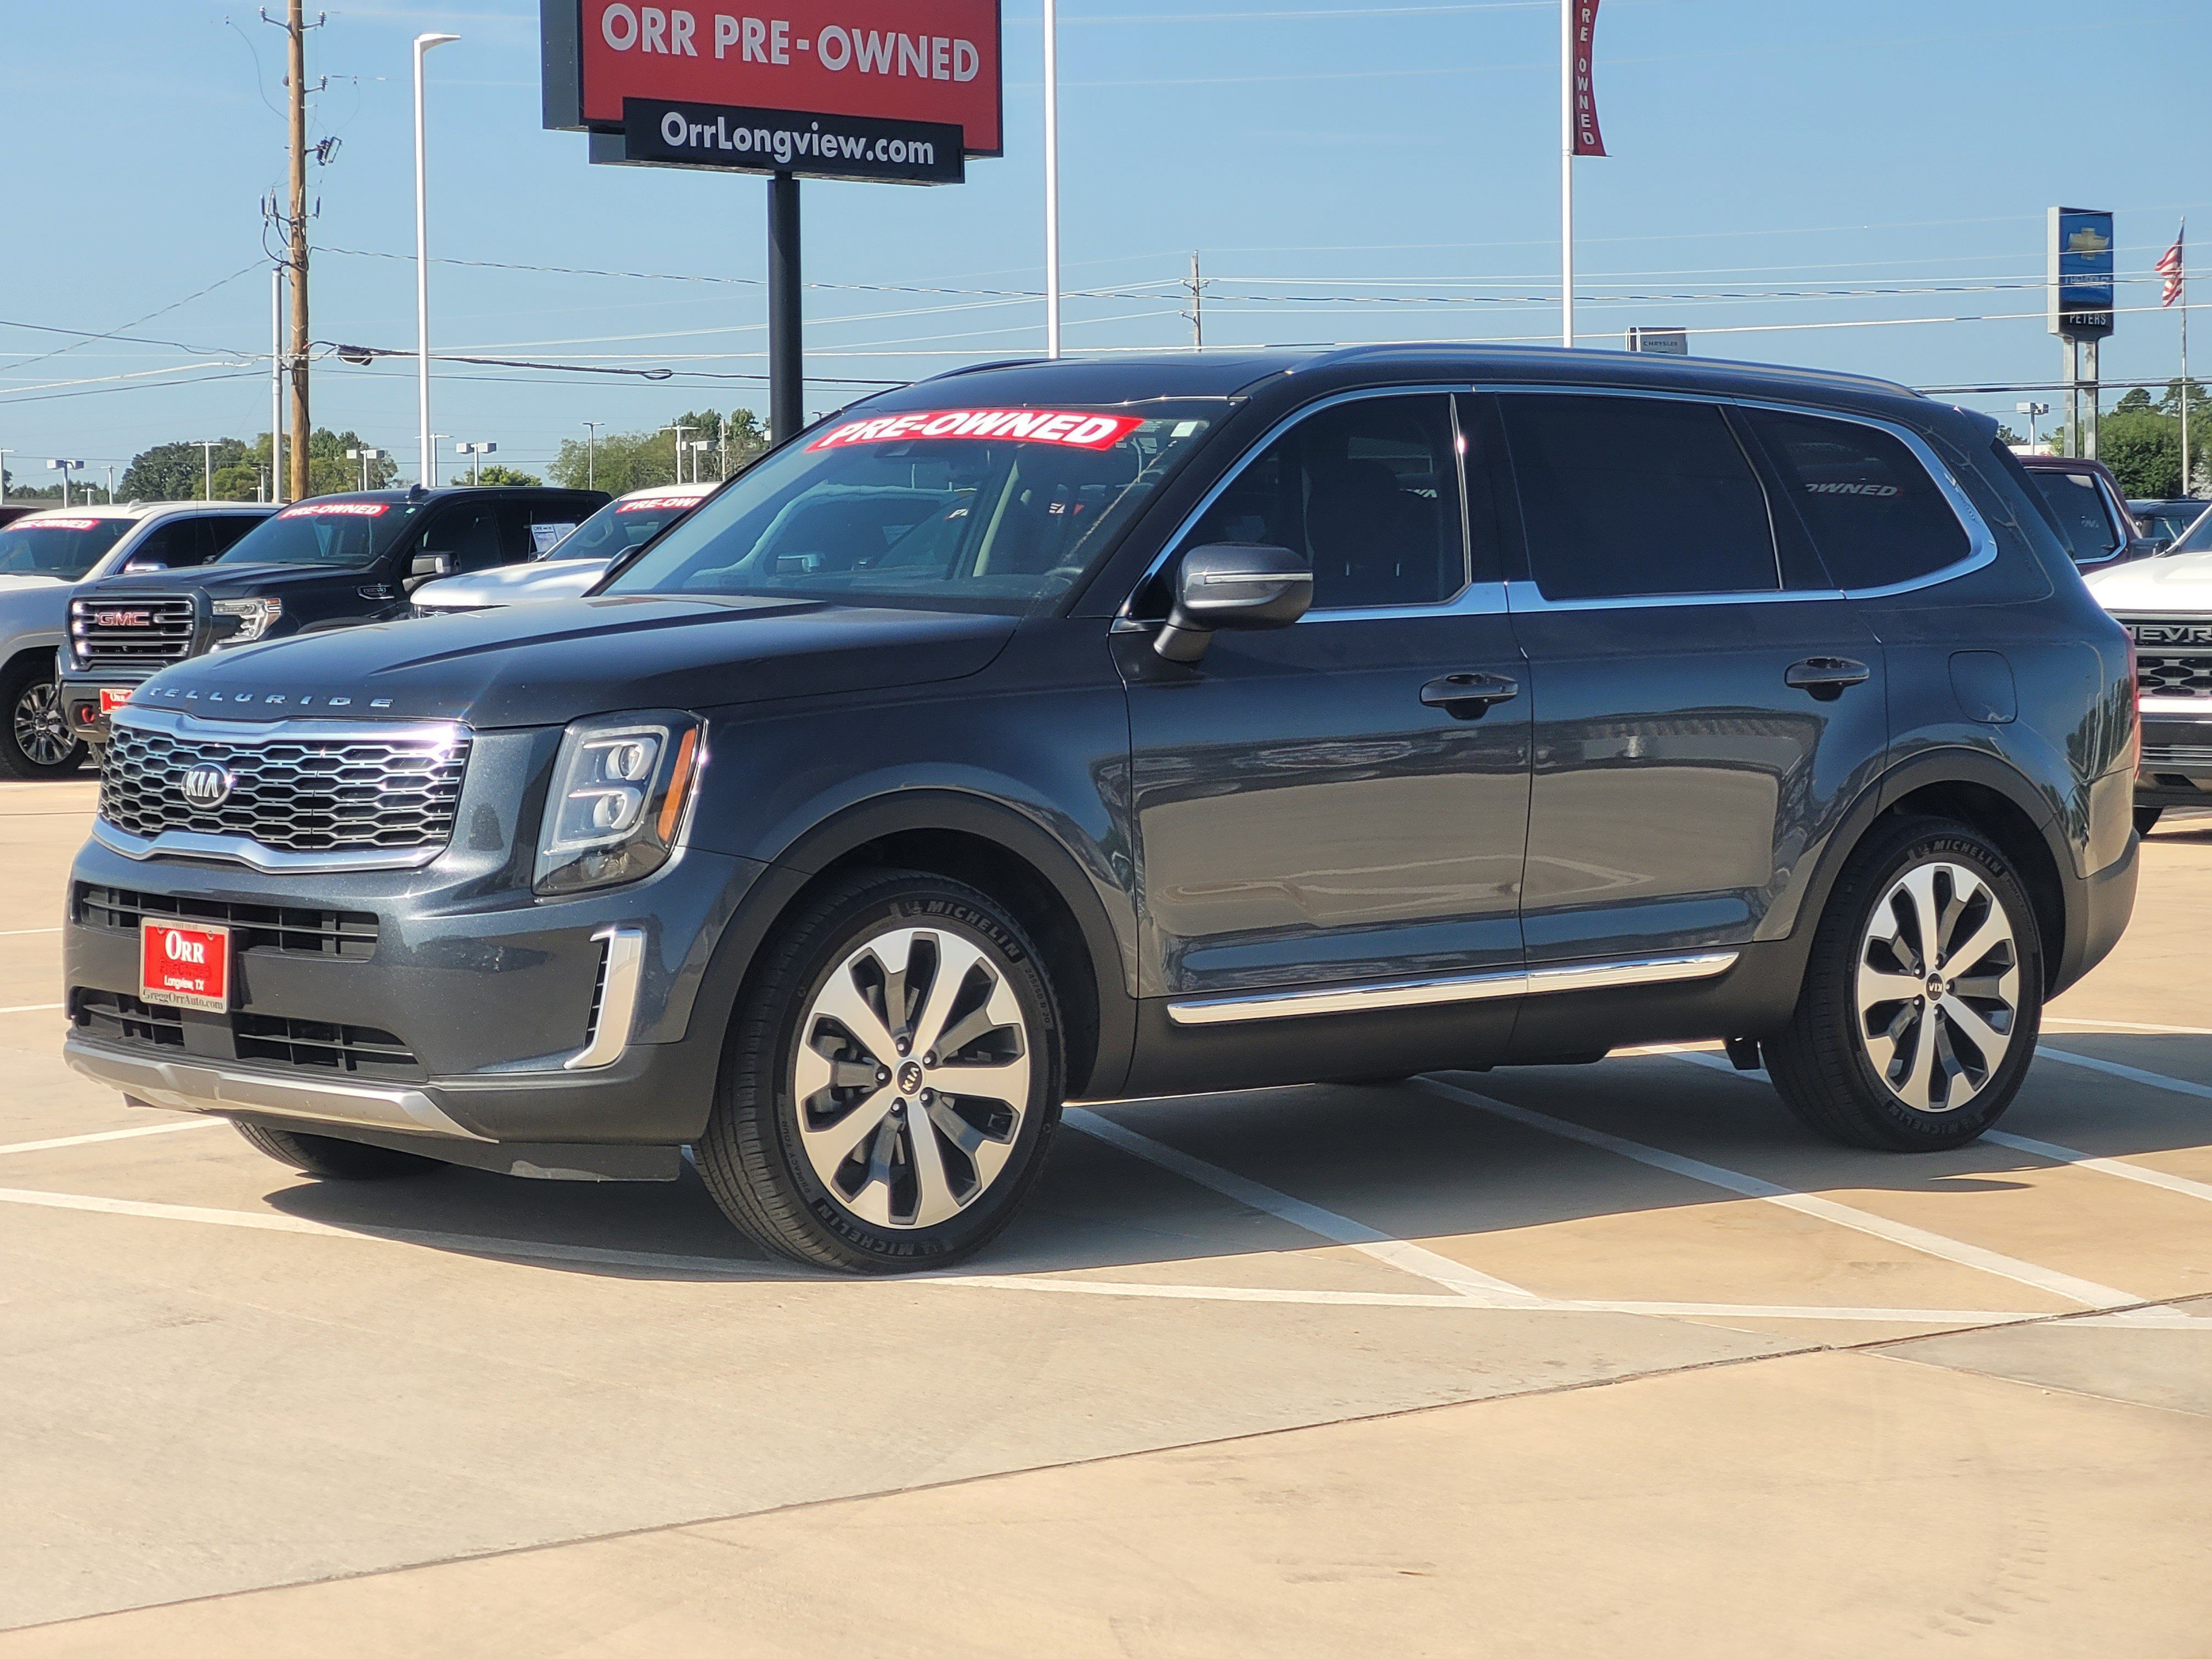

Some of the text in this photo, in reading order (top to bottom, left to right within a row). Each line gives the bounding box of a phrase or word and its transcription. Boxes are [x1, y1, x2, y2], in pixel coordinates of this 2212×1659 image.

[601, 3, 979, 82] ORR PRE-OWNED
[1577, 0, 1595, 145] RE OWNED
[661, 111, 935, 165] OrrLongview.com
[2069, 313, 2106, 325] PETERS
[818, 412, 1118, 448] PRE-OWNED
[281, 504, 382, 518] PRE-OWNED
[98, 612, 150, 626] GMC
[149, 687, 395, 708] TELLURIDE
[186, 771, 219, 798] KIA
[1934, 840, 2002, 872] MICHELIN
[927, 900, 1020, 957] MICHELIN
[195, 979, 205, 991] TX
[1928, 983, 1943, 992] KIA
[143, 989, 223, 1009] GreggOrrAuto.com
[902, 1067, 919, 1091] KIA
[817, 1204, 915, 1256] MICHELIN
